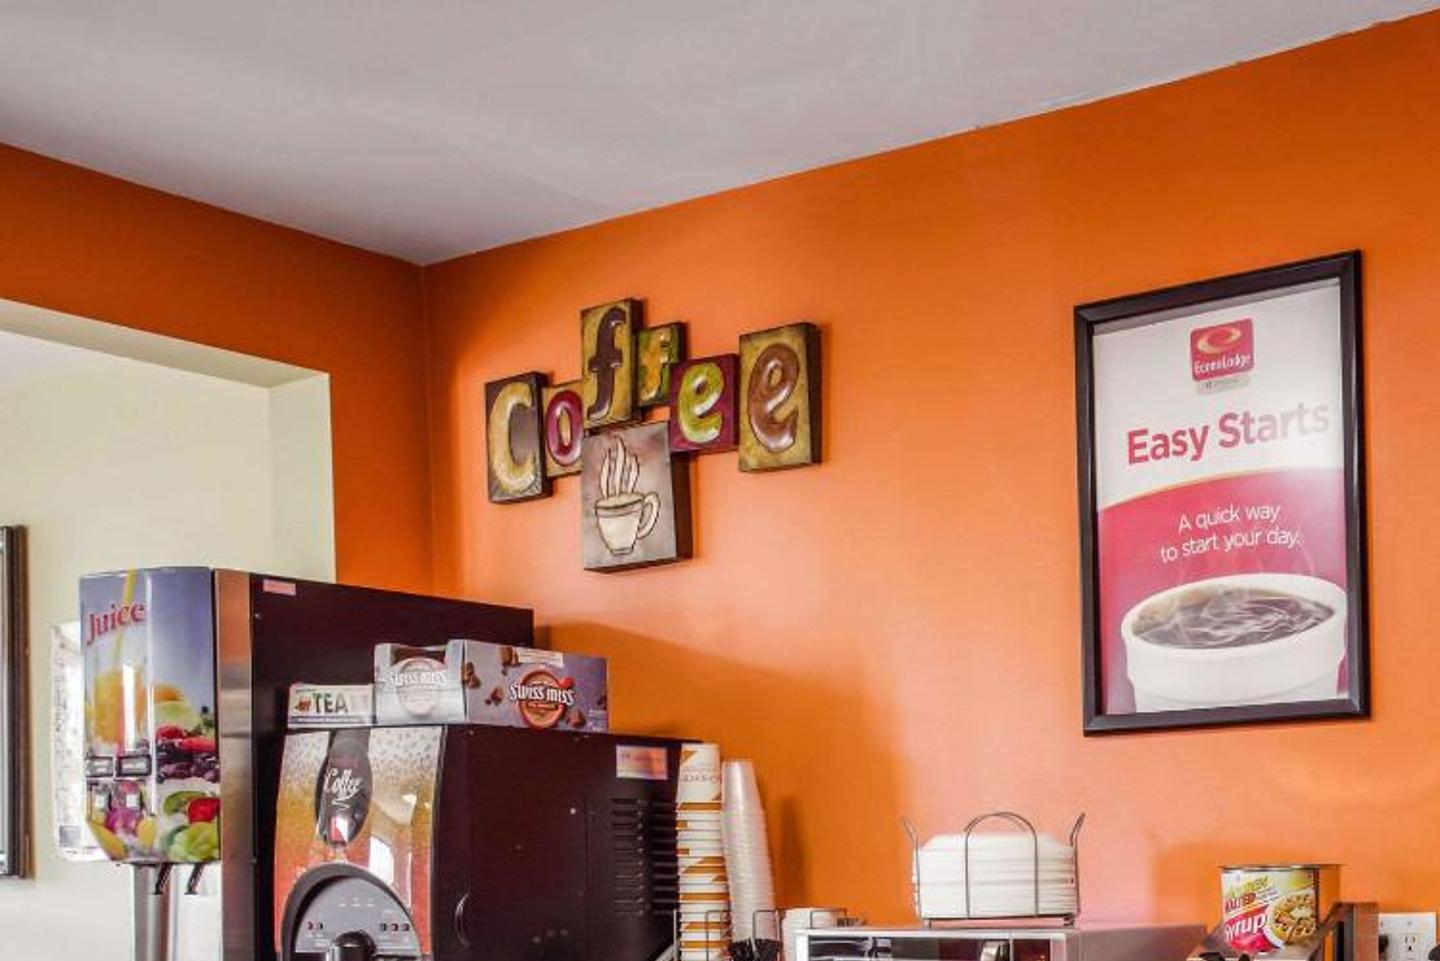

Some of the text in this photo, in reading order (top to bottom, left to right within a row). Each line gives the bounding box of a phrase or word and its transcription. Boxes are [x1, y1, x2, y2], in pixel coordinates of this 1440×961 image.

[1127, 402, 1330, 465] Easy Starts
[1177, 503, 1281, 534] A quick way
[1160, 526, 1300, 563] to start your day.
[86, 602, 147, 646] Juice
[312, 692, 349, 714] TEA
[323, 767, 362, 803] Coffee
